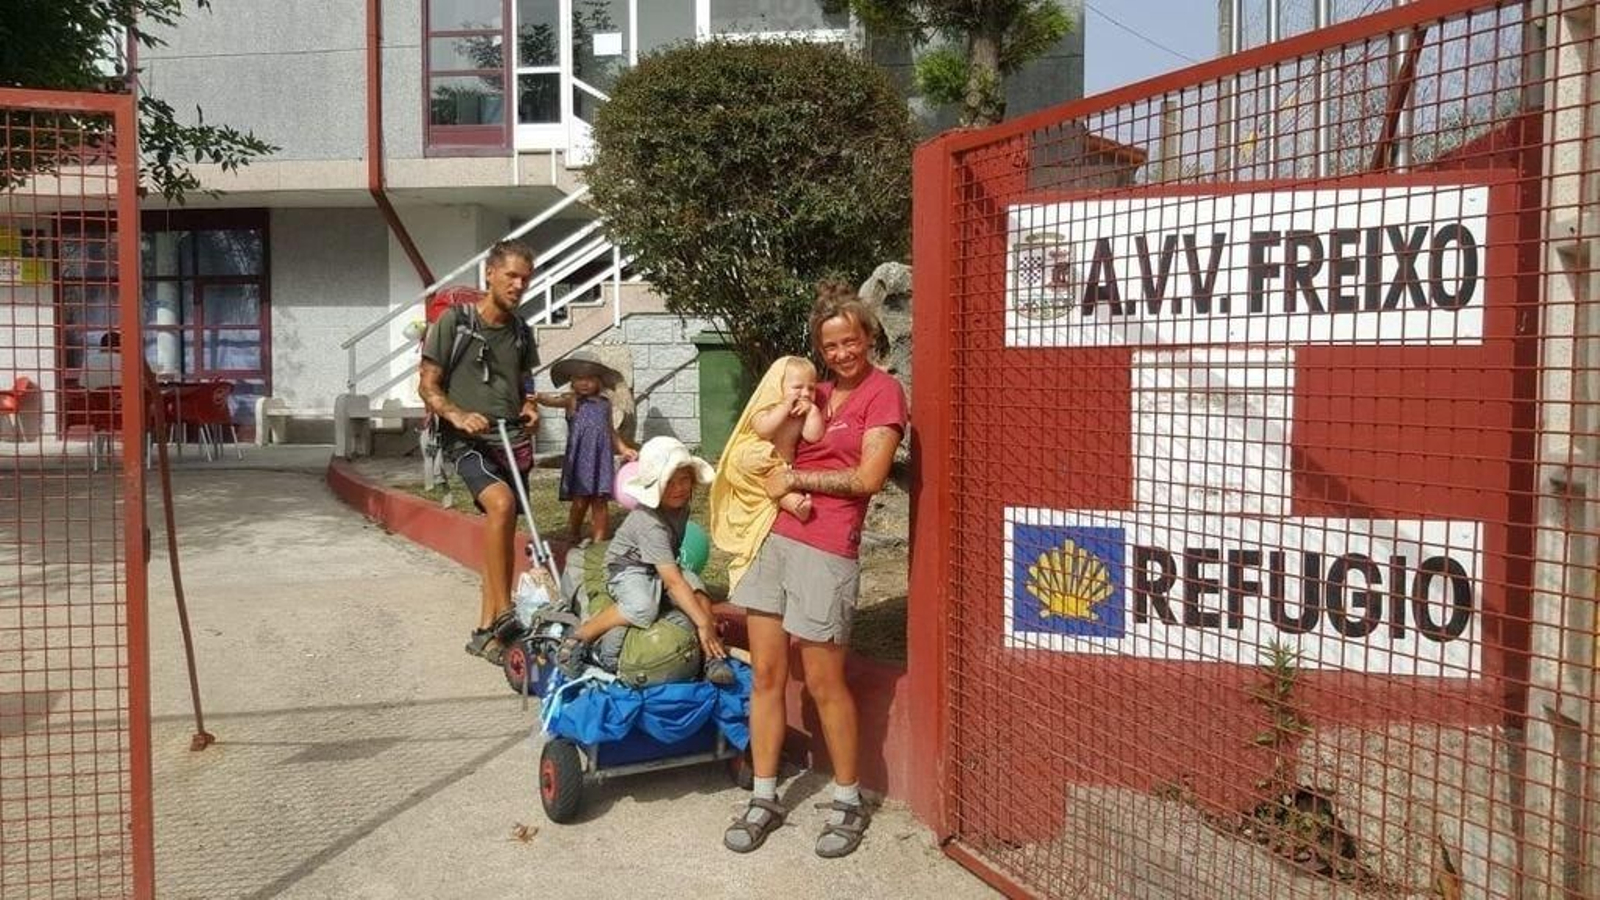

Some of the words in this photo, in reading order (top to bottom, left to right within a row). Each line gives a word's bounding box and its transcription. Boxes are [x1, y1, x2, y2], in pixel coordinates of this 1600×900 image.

[1081, 231, 1231, 316] A.V.V.
[1248, 223, 1478, 315] FREIXO
[1131, 544, 1474, 643] REFUGIO
